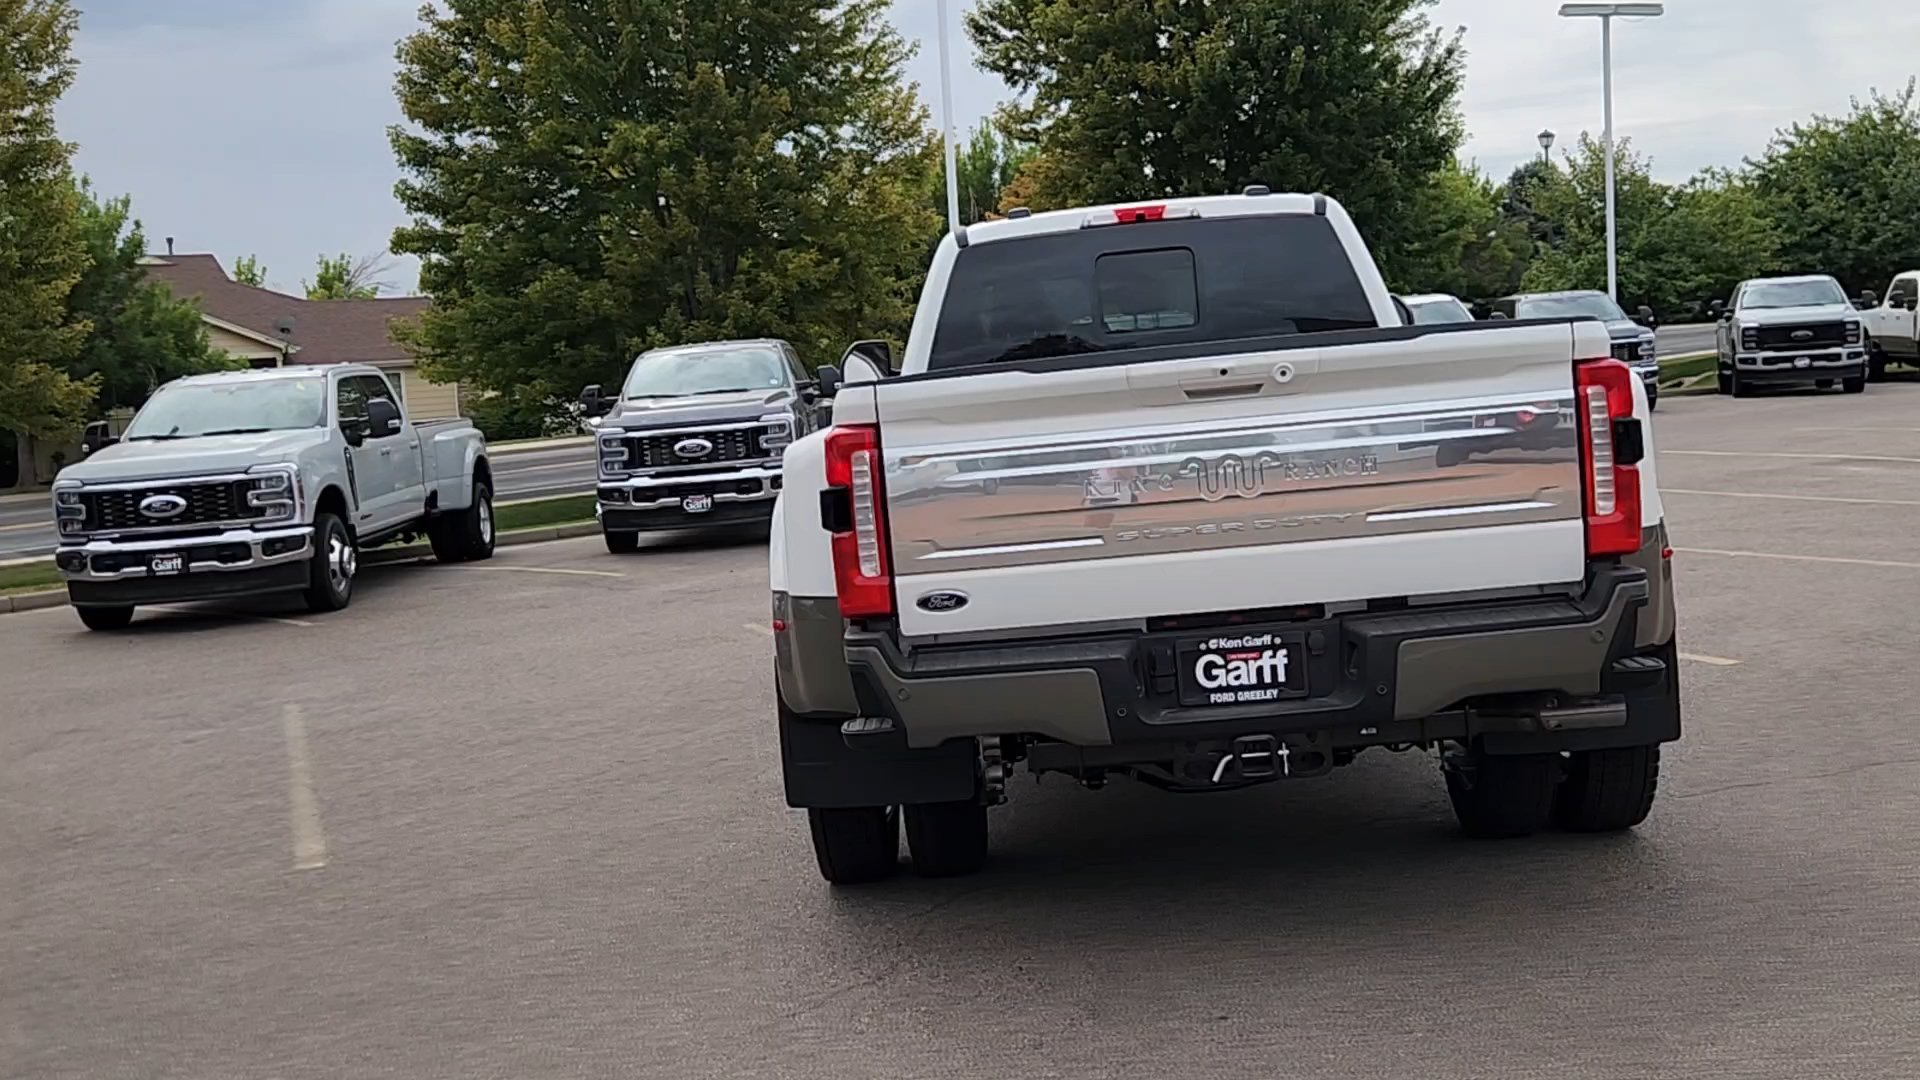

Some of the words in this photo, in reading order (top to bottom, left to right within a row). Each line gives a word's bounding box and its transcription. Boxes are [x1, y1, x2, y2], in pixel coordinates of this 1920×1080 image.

[1284, 453, 1379, 482] RANCH
[1115, 521, 1246, 542] SUPER
[151, 557, 182, 572] Garff
[928, 595, 957, 609] Ford
[1219, 637, 1242, 649] Ken
[1242, 634, 1272, 647] Garff
[1195, 648, 1288, 688] Garff
[1210, 692, 1235, 703] FORD
[1237, 689, 1278, 701] GREELEY
